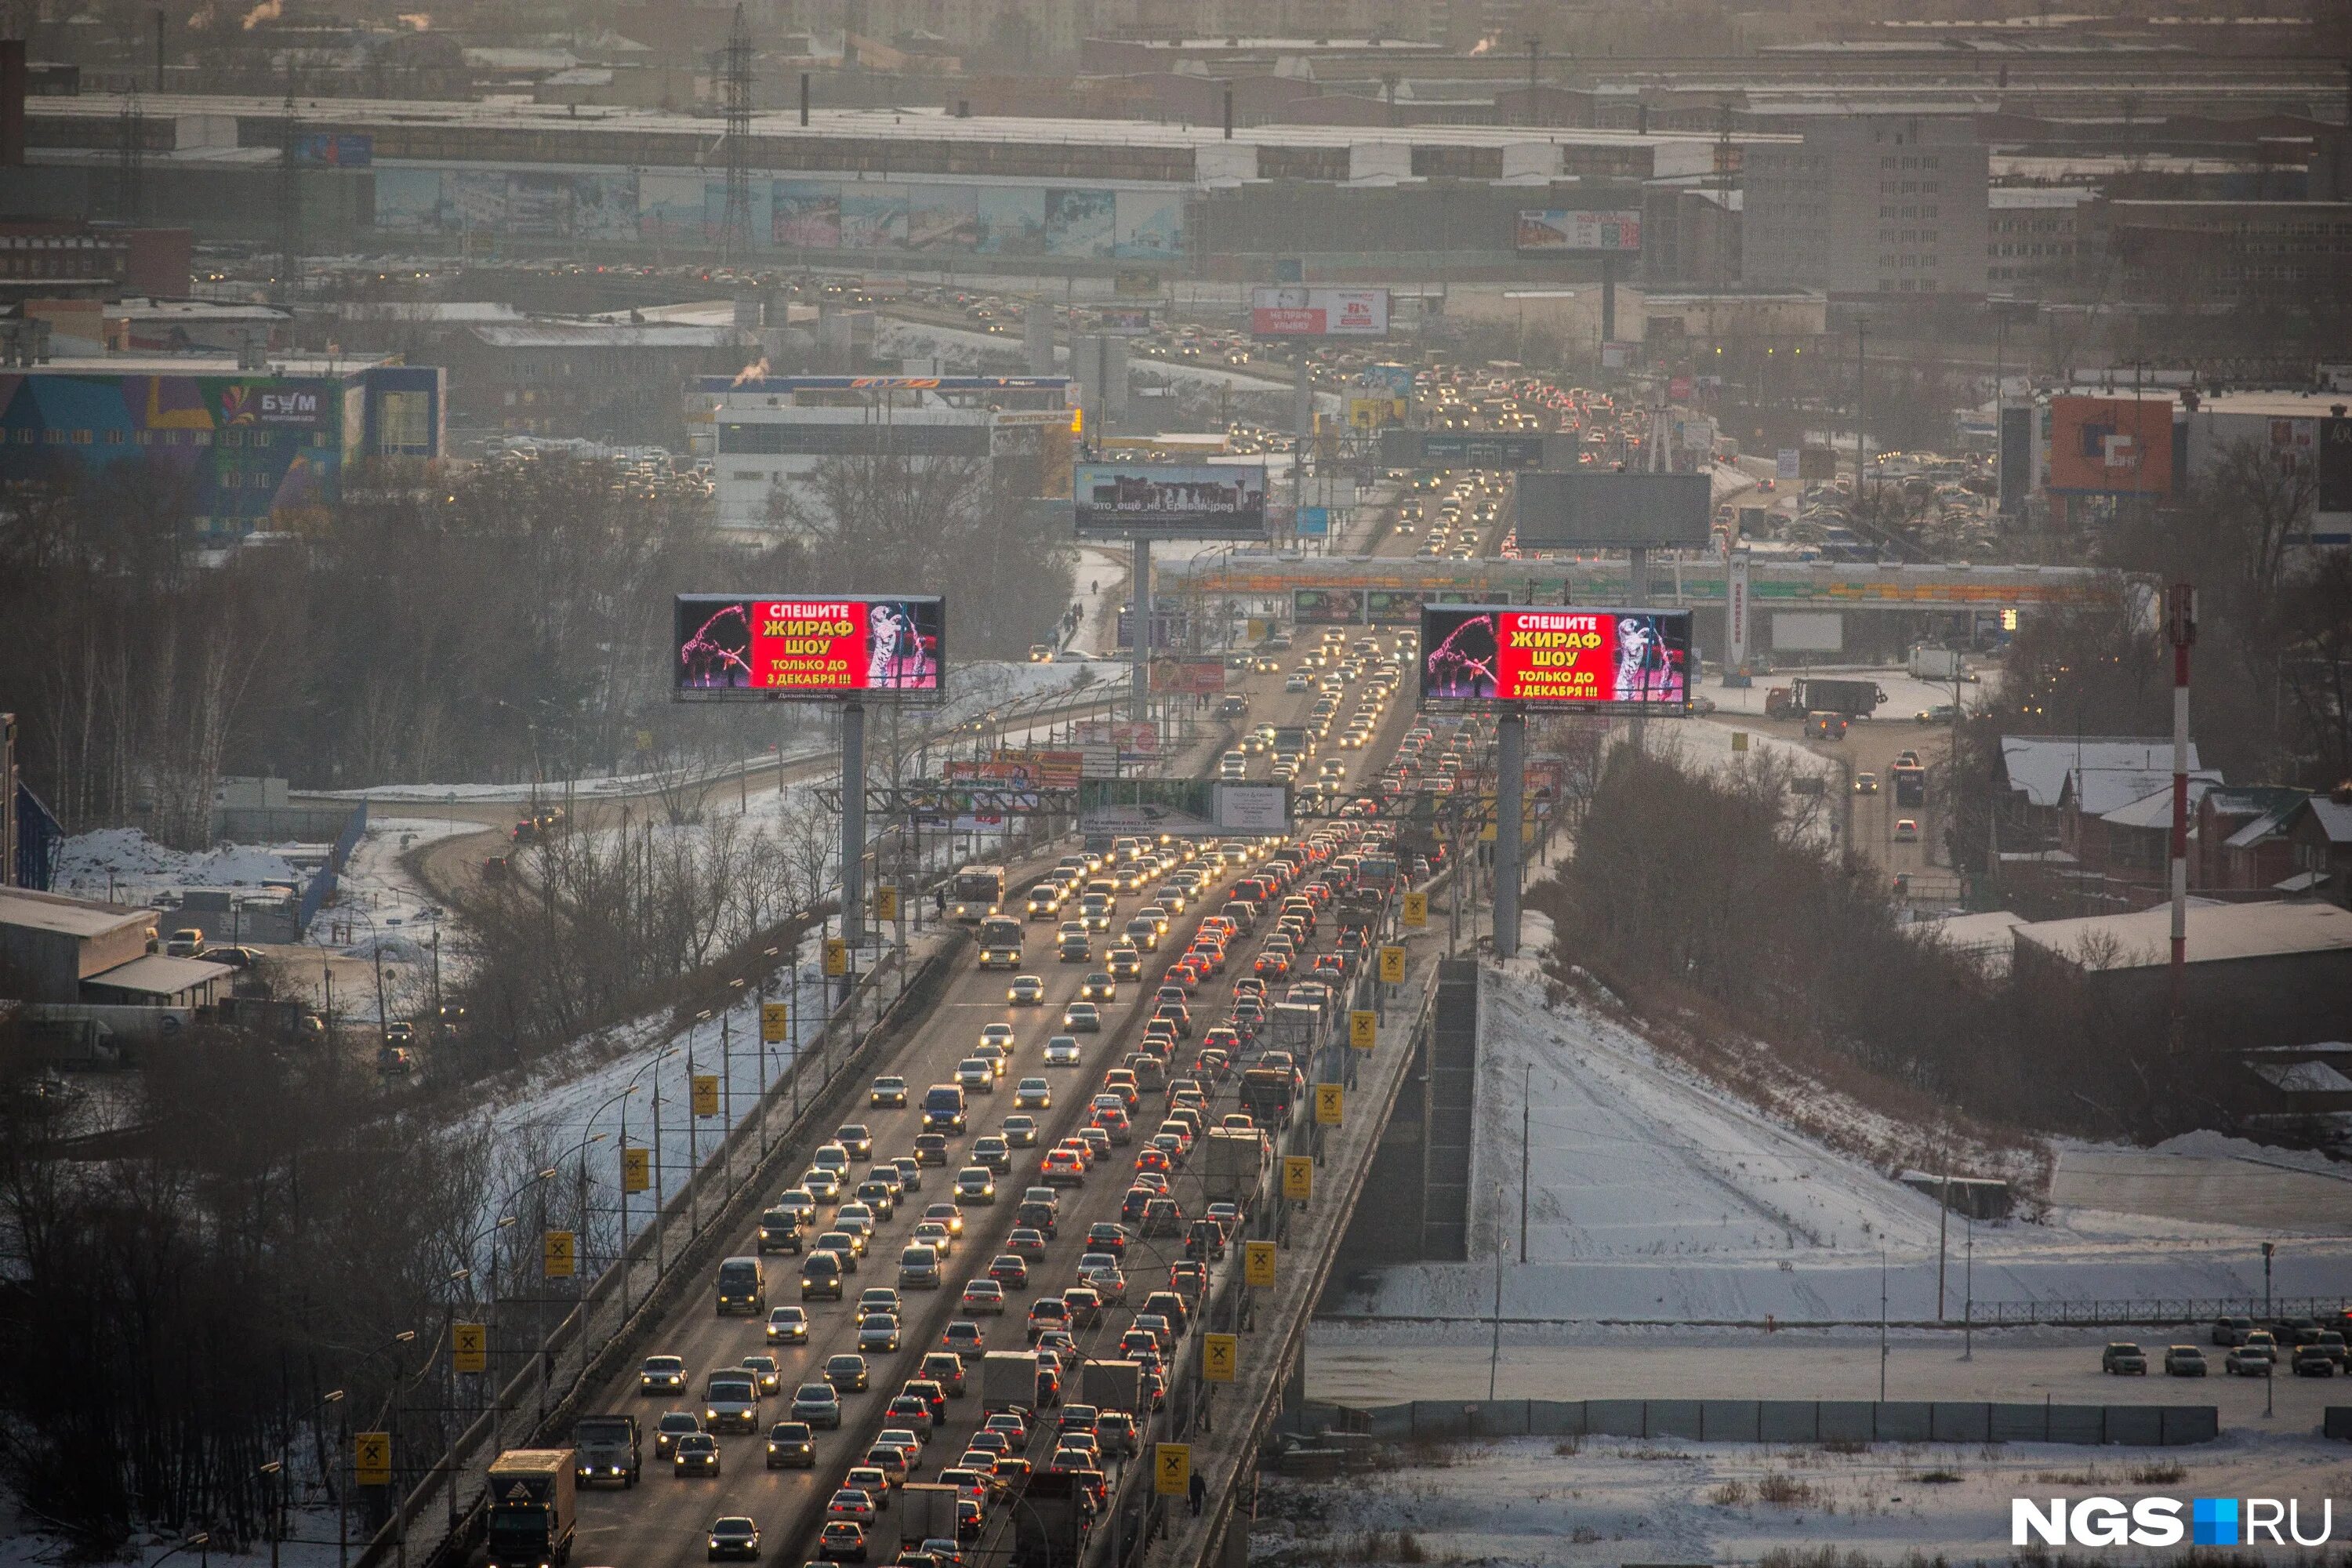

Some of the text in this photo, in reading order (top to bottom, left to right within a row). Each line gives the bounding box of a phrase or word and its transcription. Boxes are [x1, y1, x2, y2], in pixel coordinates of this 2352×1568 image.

[770, 604, 849, 618] СПЕШИТЕ
[763, 620, 854, 637] ЖИРАФ
[1518, 615, 1597, 630] СПЕШИТЕ
[785, 640, 831, 655] ШОУ
[1510, 632, 1602, 649] ЖИРАФ
[771, 660, 848, 671] ТОЛЬКО ДО
[1532, 651, 1578, 666] ШОУ
[768, 674, 775, 684] 3
[776, 674, 836, 685] ДЕКАБРЯ
[1518, 671, 1595, 684] ТОЛЬКО ДО
[1513, 684, 1521, 695] 3
[1523, 685, 1582, 696] ДЕКАБРЯ
